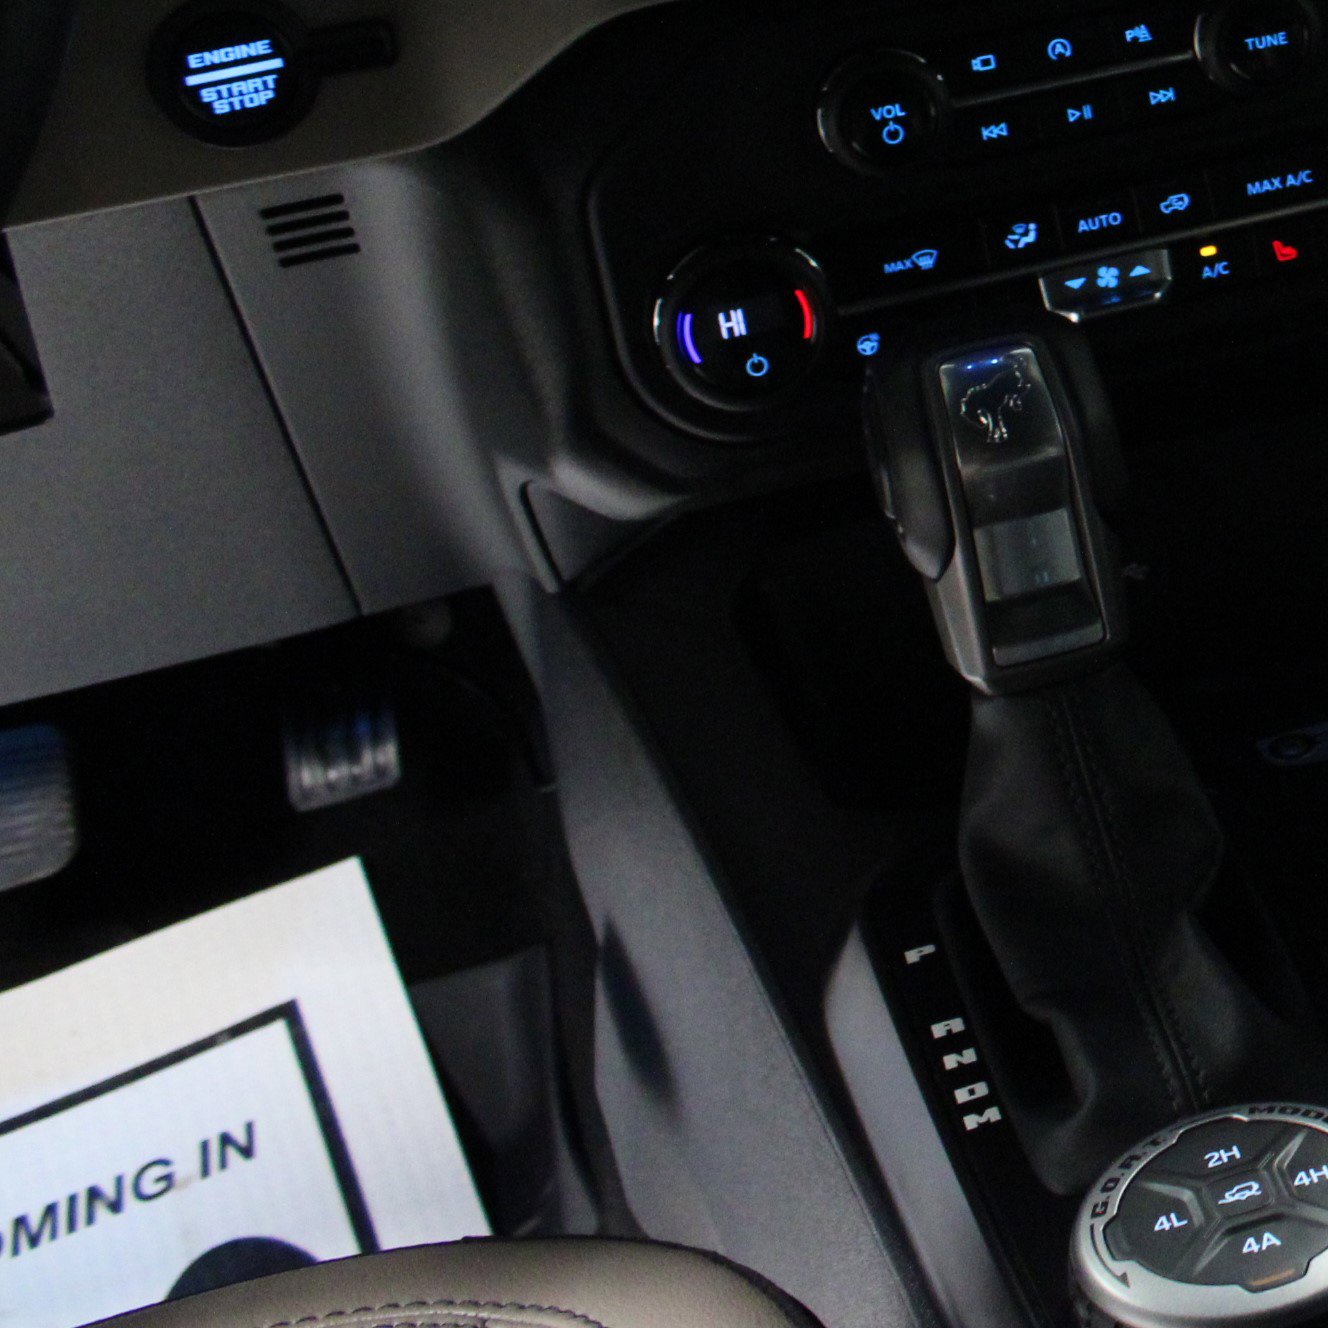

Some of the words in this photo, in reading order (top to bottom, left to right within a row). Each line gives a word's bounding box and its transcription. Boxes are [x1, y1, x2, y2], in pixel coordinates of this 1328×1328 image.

[1244, 30, 1289, 51] TUNE
[186, 38, 274, 69] ENGINE
[199, 74, 278, 103] START
[211, 90, 277, 115] STOP
[870, 103, 906, 121] VOL
[1246, 176, 1284, 196] MAX
[1284, 169, 1314, 188] A/C
[1077, 211, 1123, 233] AUTO
[883, 259, 913, 274] MAX
[1201, 260, 1230, 280] A/C
[717, 308, 748, 340] HI
[904, 944, 936, 965] P
[930, 1017, 965, 1040] R
[942, 1047, 978, 1071] N
[953, 1081, 989, 1105] D
[962, 1105, 1002, 1132] M
[1204, 1145, 1242, 1168] 2H
[0, 1158, 176, 1257] MING
[199, 1120, 255, 1179] IN
[1154, 1212, 1188, 1232] 4L
[1242, 1231, 1282, 1254] 4A
